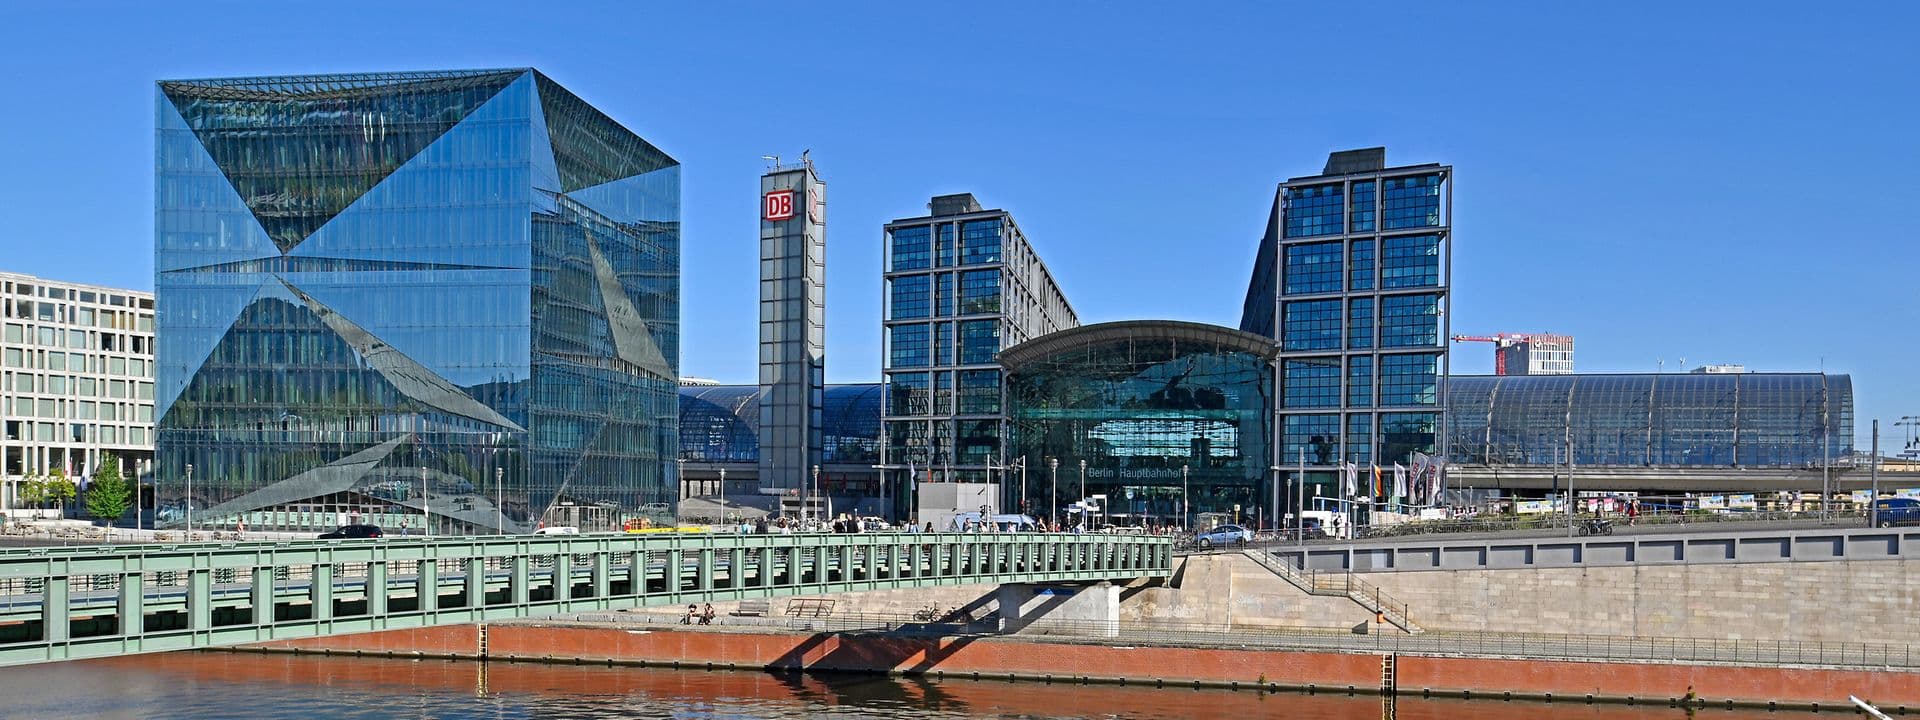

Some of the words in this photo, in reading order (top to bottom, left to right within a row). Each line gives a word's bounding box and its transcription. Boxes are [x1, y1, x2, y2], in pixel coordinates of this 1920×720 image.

[769, 196, 791, 216] DB
[1089, 468, 1114, 478] Berlin
[1119, 468, 1182, 479] Hauptbahnhof
